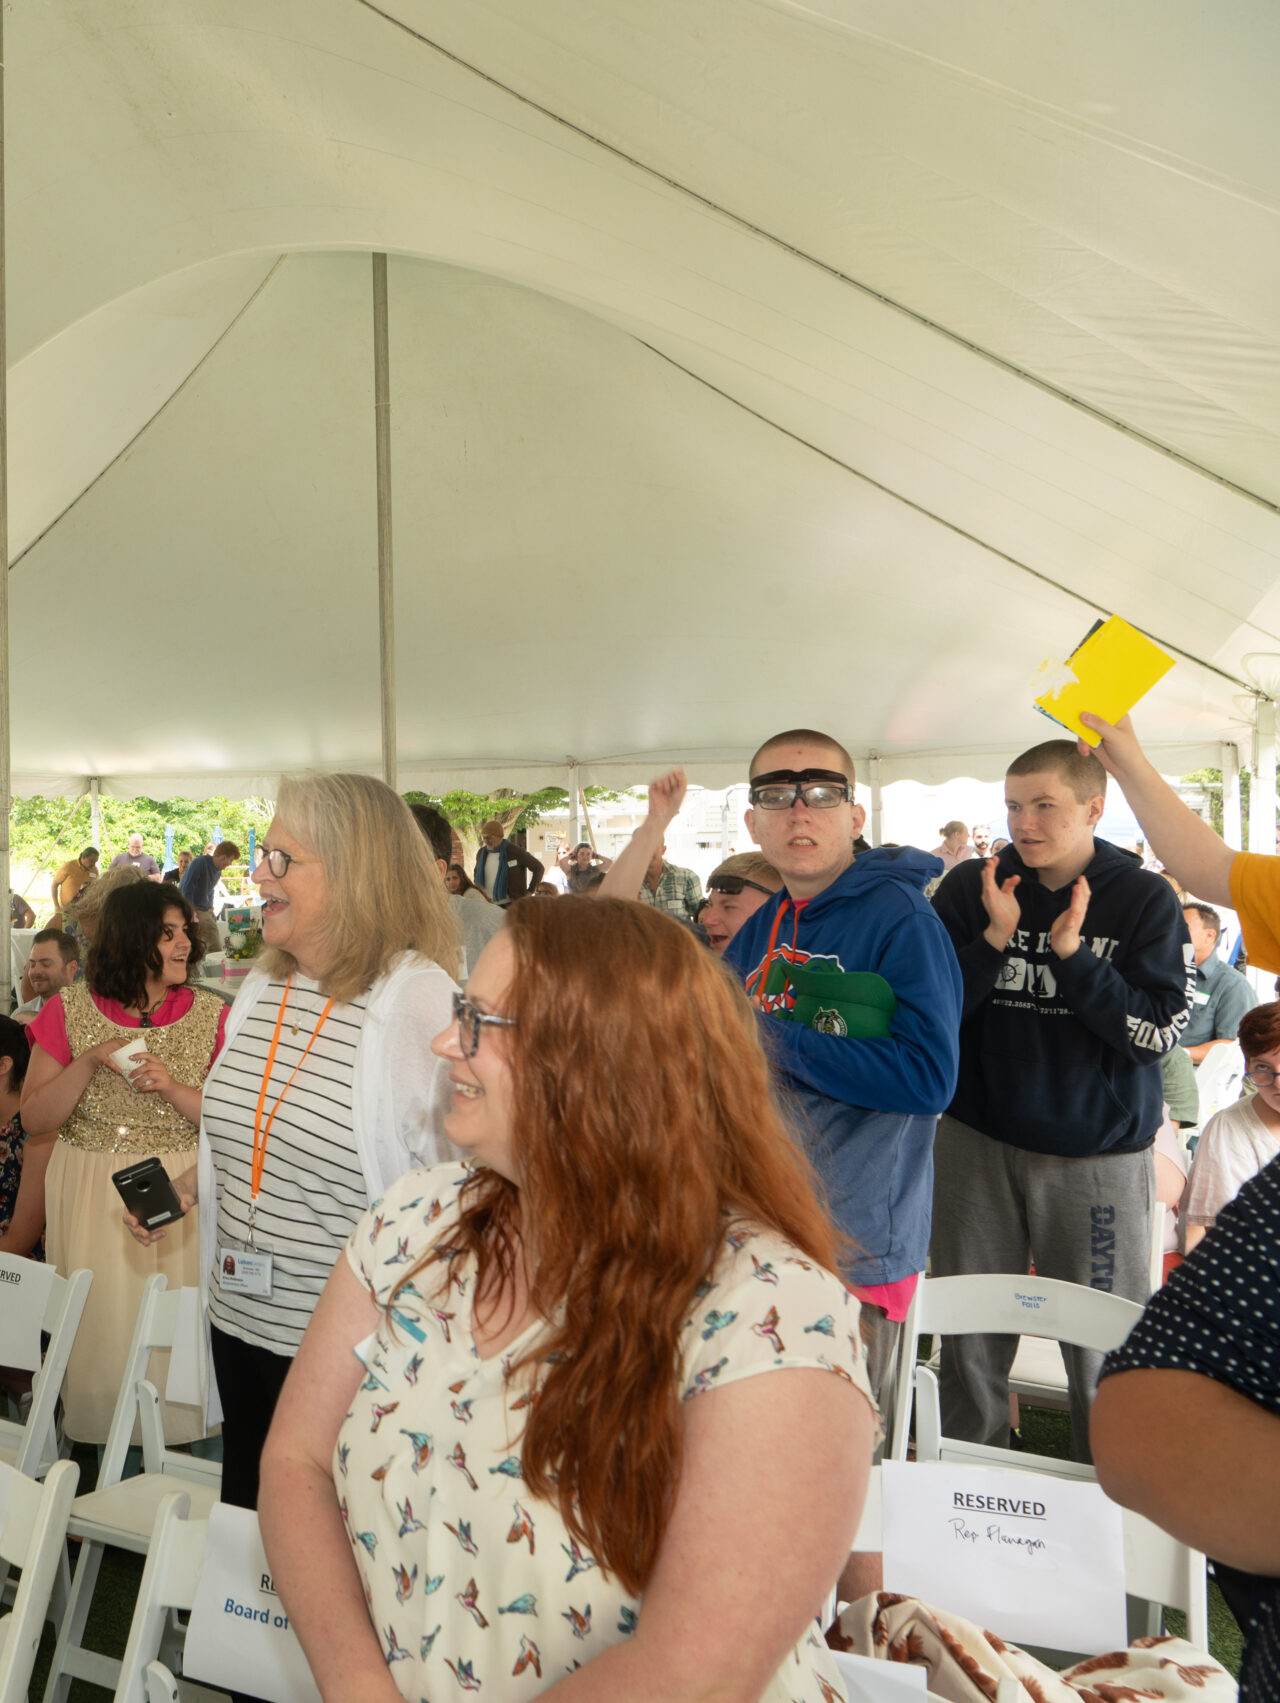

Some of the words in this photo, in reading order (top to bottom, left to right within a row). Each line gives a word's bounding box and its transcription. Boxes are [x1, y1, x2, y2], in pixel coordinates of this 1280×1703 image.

[1090, 1204, 1116, 1293] DAYTO
[952, 1491, 1047, 1517] RESERVED
[947, 1517, 980, 1544] Rep
[224, 1597, 271, 1625] Board
